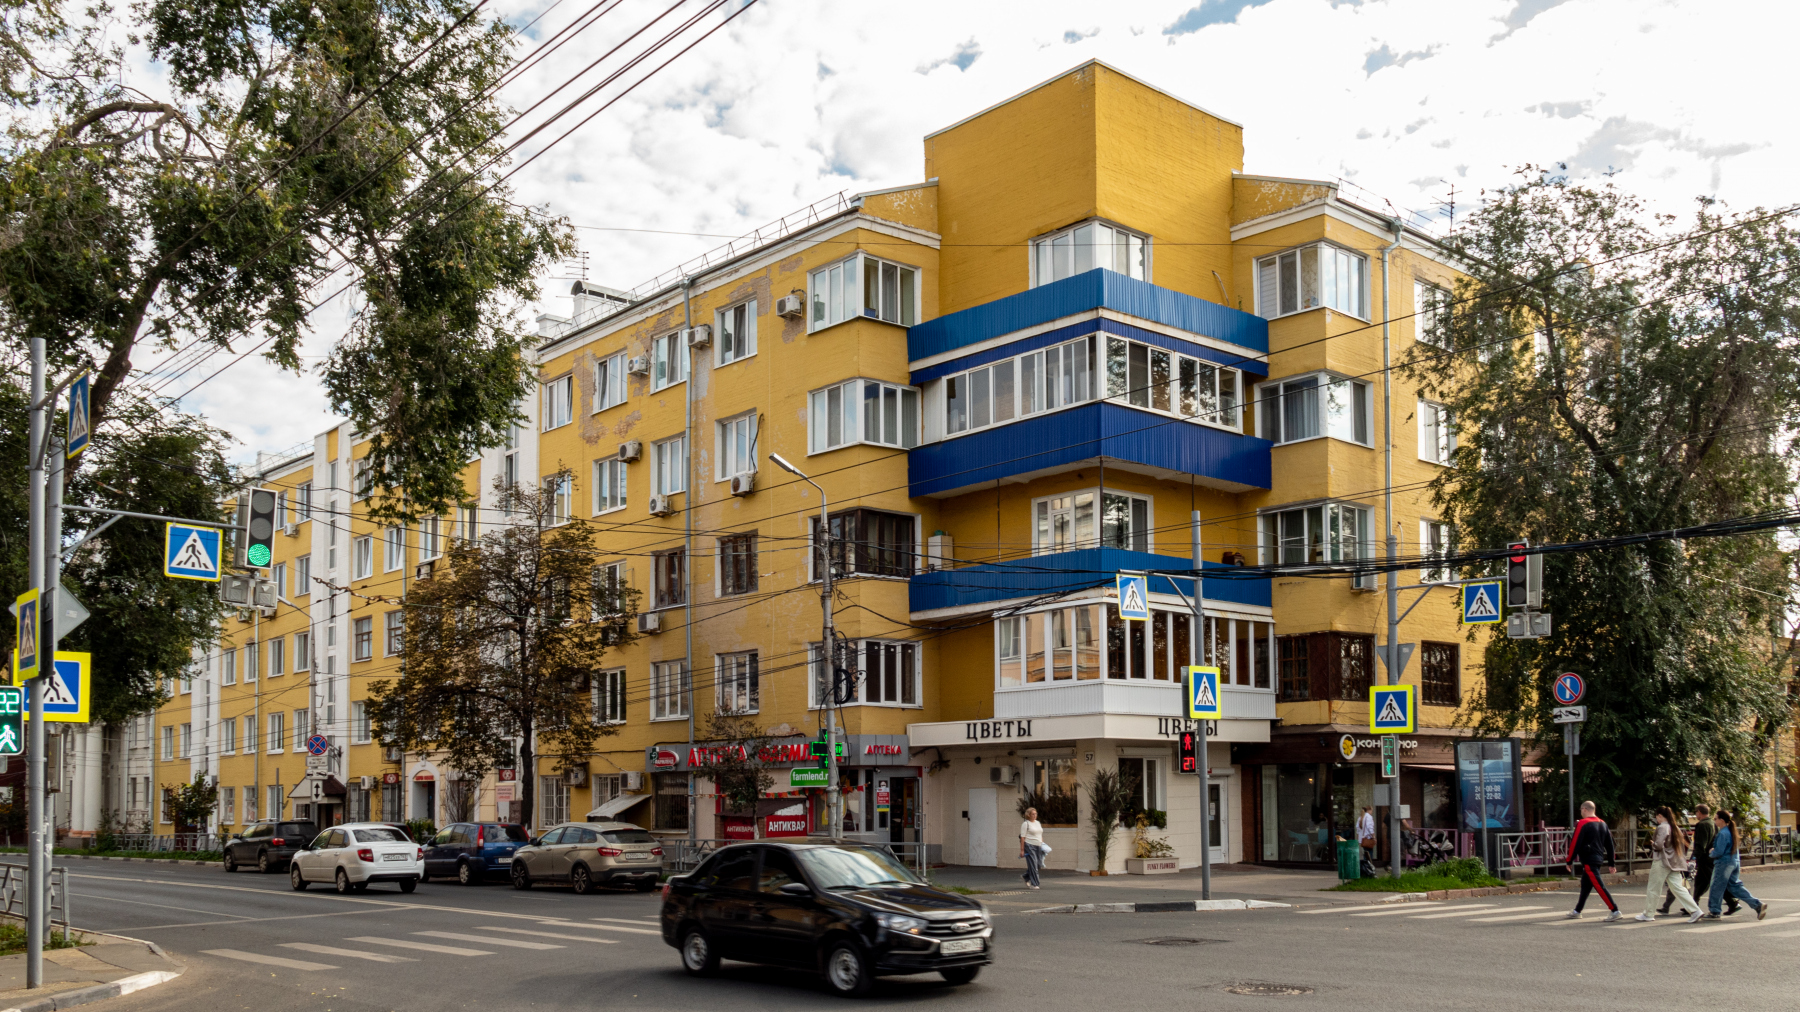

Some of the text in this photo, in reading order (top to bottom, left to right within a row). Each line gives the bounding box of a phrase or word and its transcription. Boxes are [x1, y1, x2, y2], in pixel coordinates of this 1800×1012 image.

[966, 719, 1032, 742] ЦВЕТЫ
[865, 745, 902, 755] АПТЕКА
[1085, 753, 1094, 761] 57
[1183, 757, 1195, 770] 27
[792, 771, 829, 781] farmlend.r
[768, 821, 805, 832] АНТИКВАР
